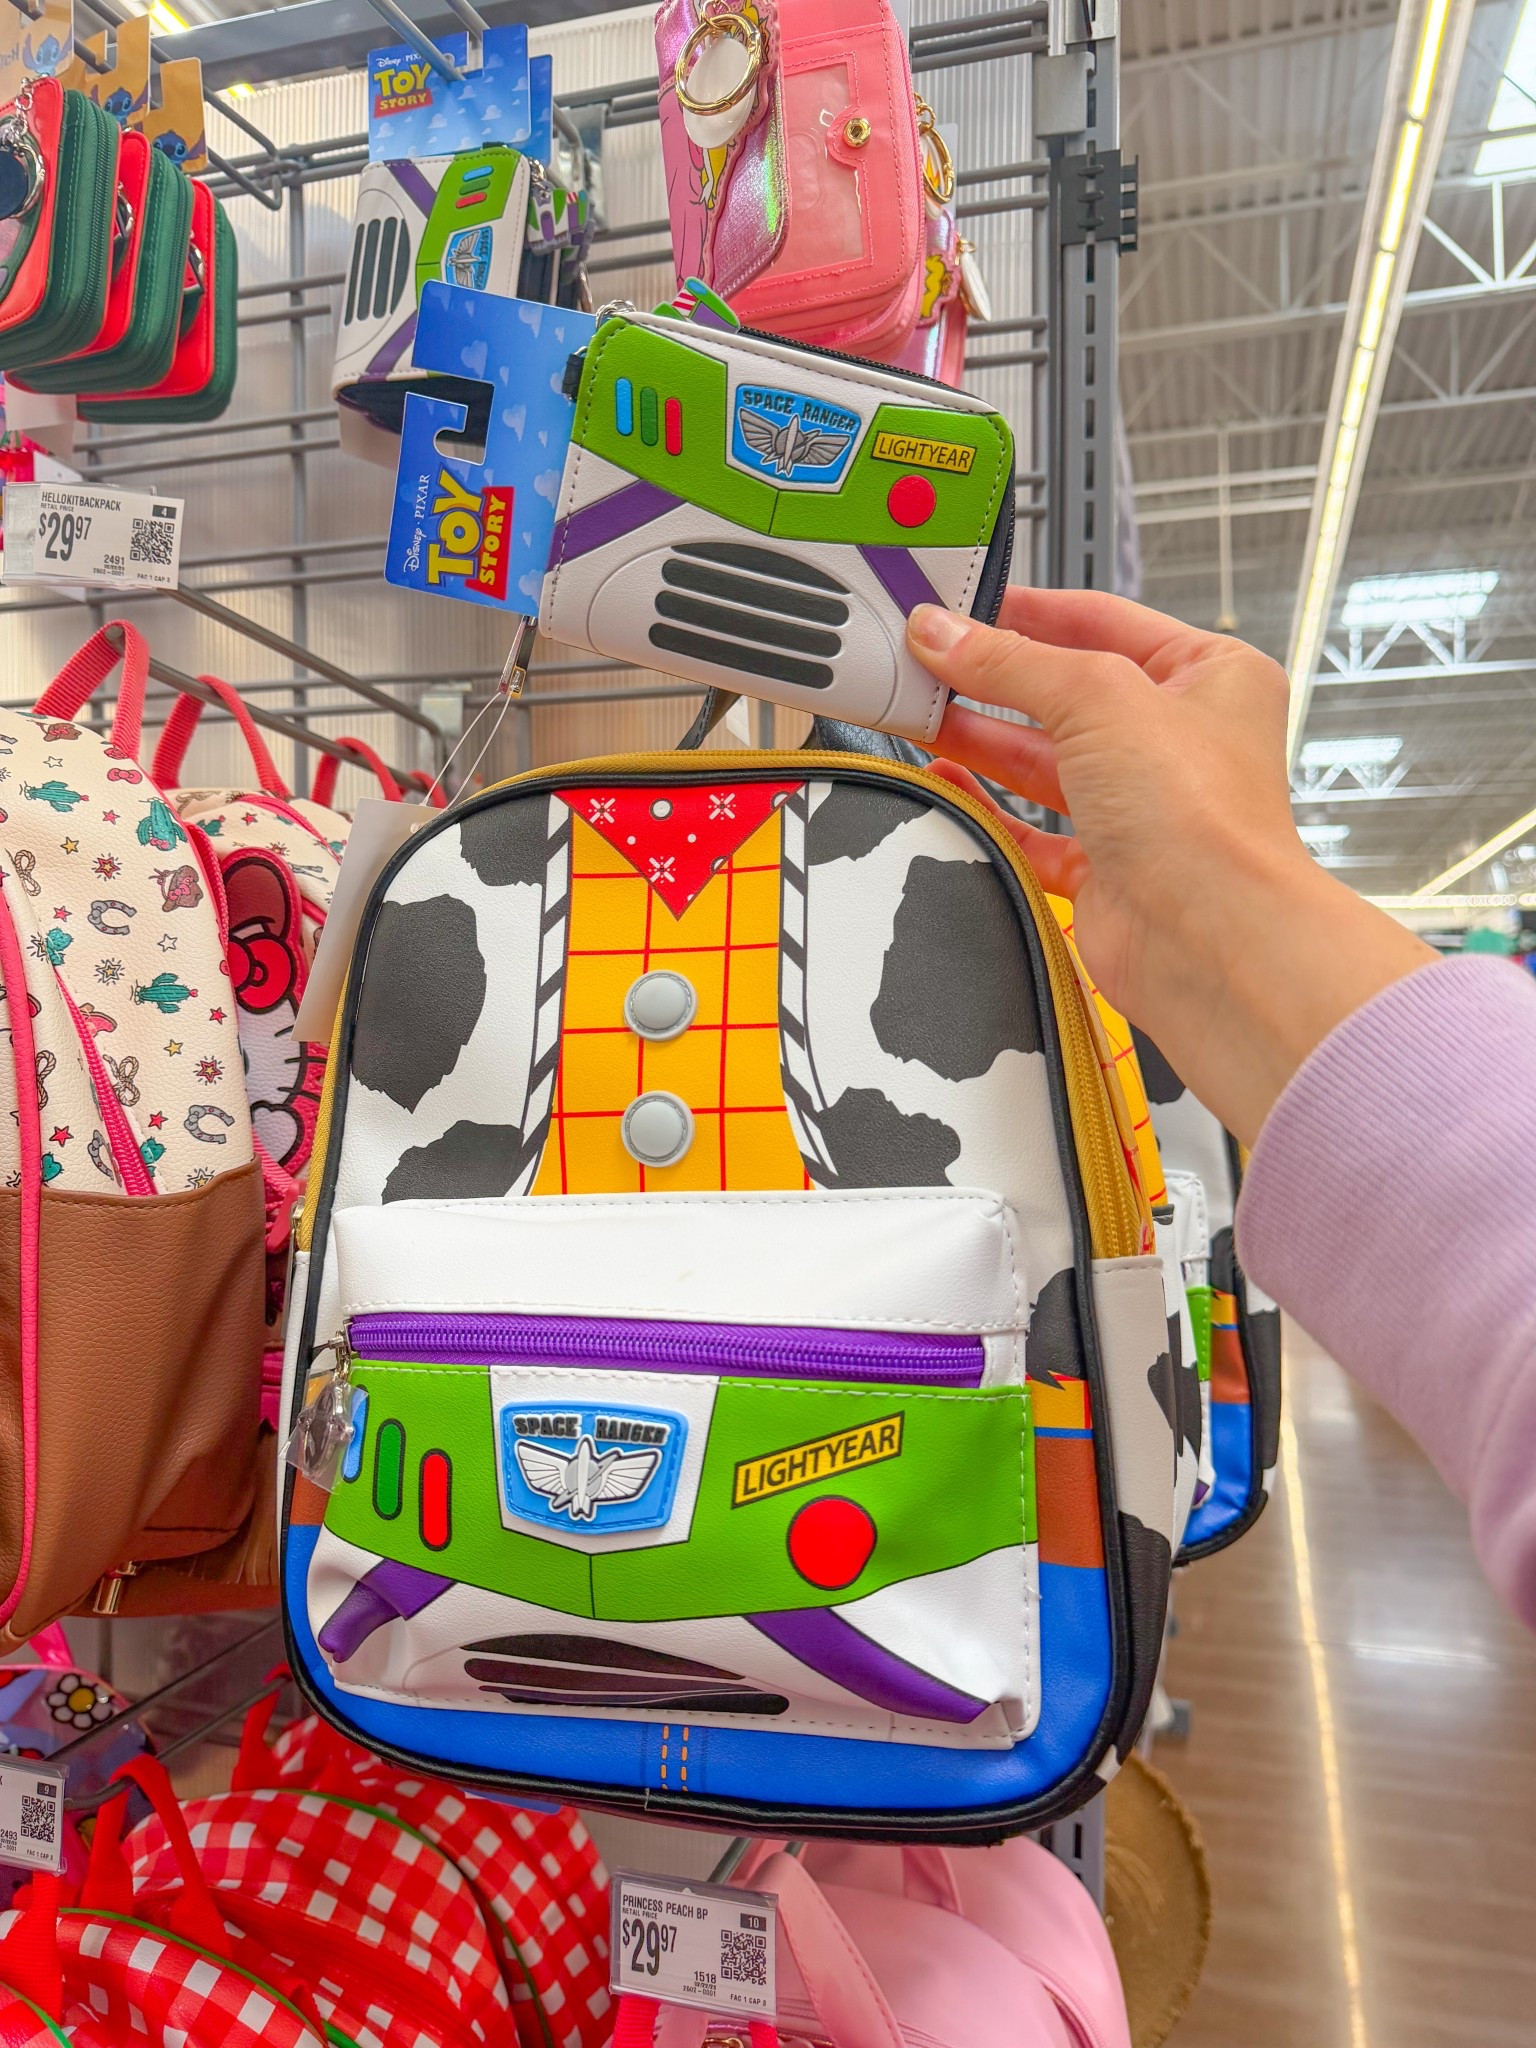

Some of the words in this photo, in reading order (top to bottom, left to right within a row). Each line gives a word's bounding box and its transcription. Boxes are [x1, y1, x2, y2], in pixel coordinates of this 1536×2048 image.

[373, 62, 432, 97] TOY
[379, 92, 427, 110] STORY
[742, 389, 795, 415] SPACE
[801, 401, 857, 432] RANGER
[878, 436, 970, 468] LIGHTYEAR
[40, 502, 58, 511] RETAIL
[59, 504, 74, 513] PRICE
[41, 491, 122, 512] HELLOKITBACKPACK
[414, 474, 431, 520] PIXAR
[426, 468, 483, 585] TOY
[479, 494, 507, 586] STORY
[103, 554, 125, 566] 2491
[513, 1415, 580, 1438] SPACE
[594, 1417, 668, 1444] RANGER
[742, 1423, 897, 1497] LIGHTYEAR
[0, 1828, 18, 1841] 2493
[622, 1894, 663, 1913] PRINCESS
[665, 1902, 694, 1918] PEACH
[696, 1908, 708, 1920] BP
[622, 1907, 641, 1917] RETAIL
[642, 1910, 658, 1920] PRICE
[748, 1916, 760, 1929] 10
[694, 1970, 717, 1984] 1518
[730, 1993, 742, 2002] FAC
[748, 1997, 761, 2005] CAP
